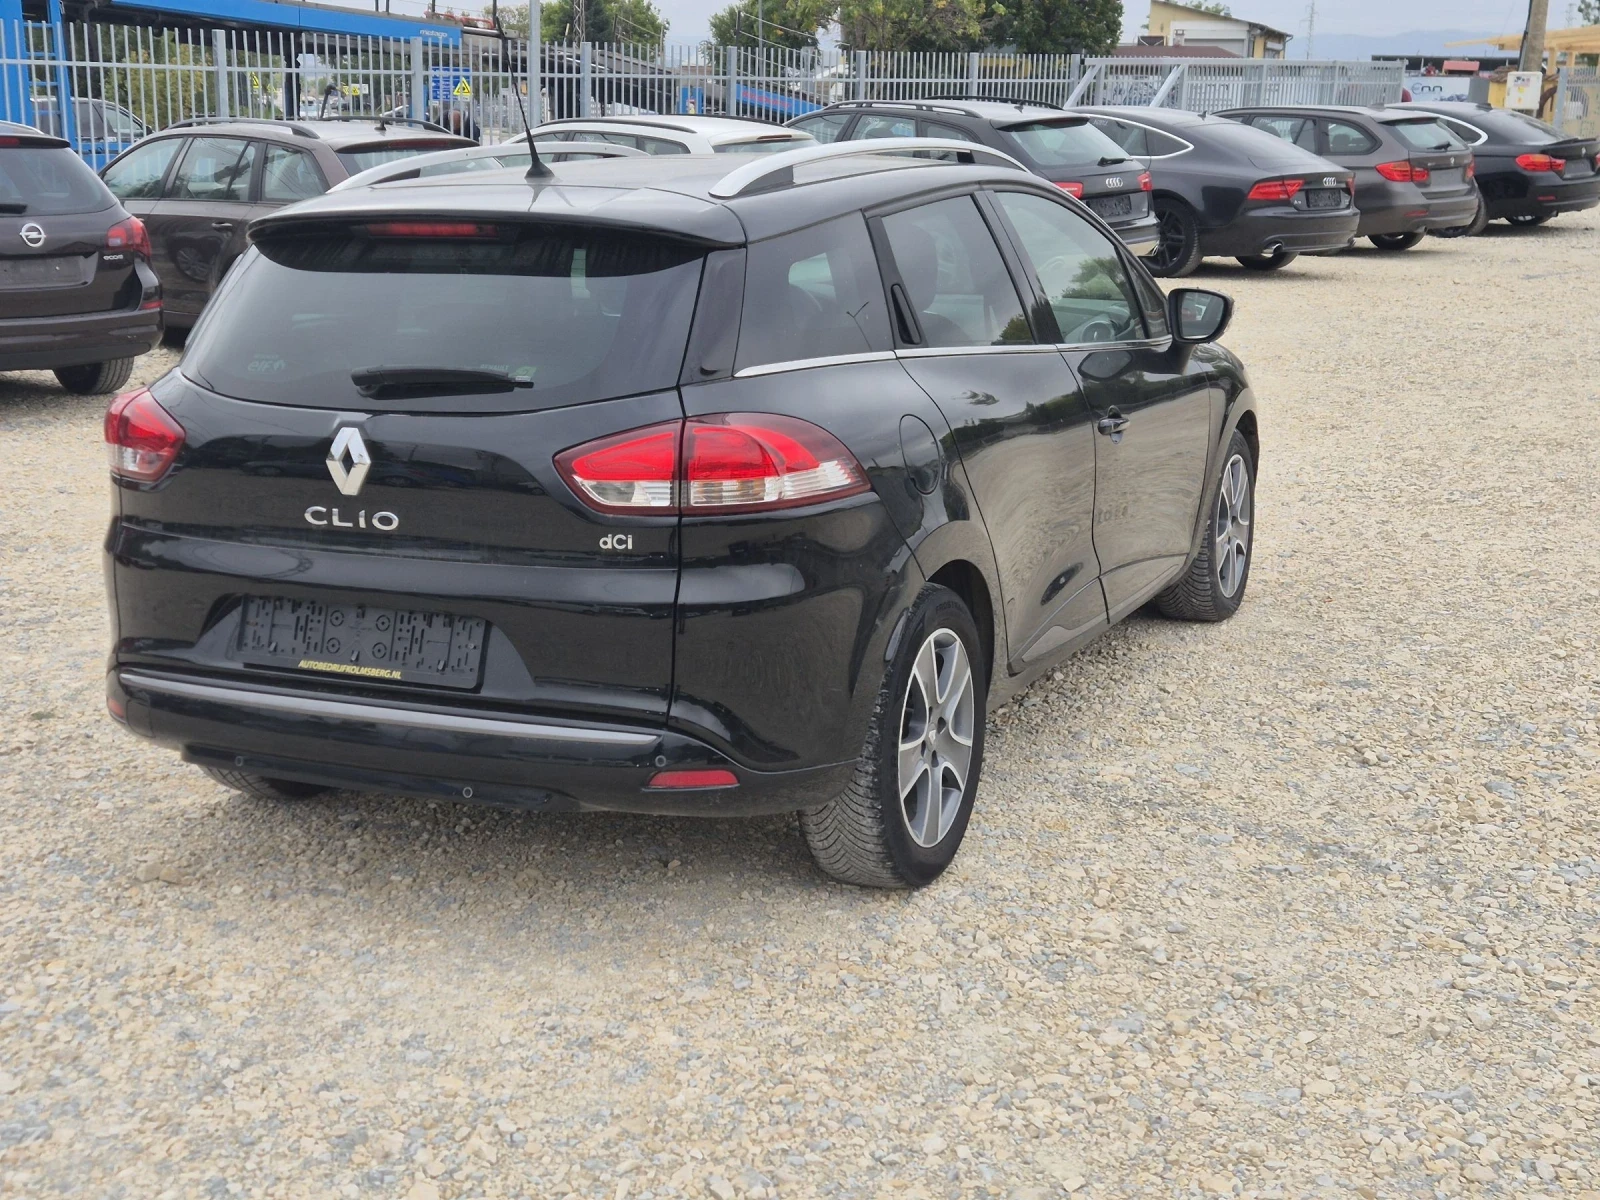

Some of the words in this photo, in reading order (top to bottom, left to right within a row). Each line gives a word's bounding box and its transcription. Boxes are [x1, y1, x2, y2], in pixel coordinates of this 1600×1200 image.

[304, 505, 399, 531] CLIO
[599, 533, 633, 550] dCi
[298, 659, 402, 679] AUTOBEDRIJFKOLMSBERG.NL
